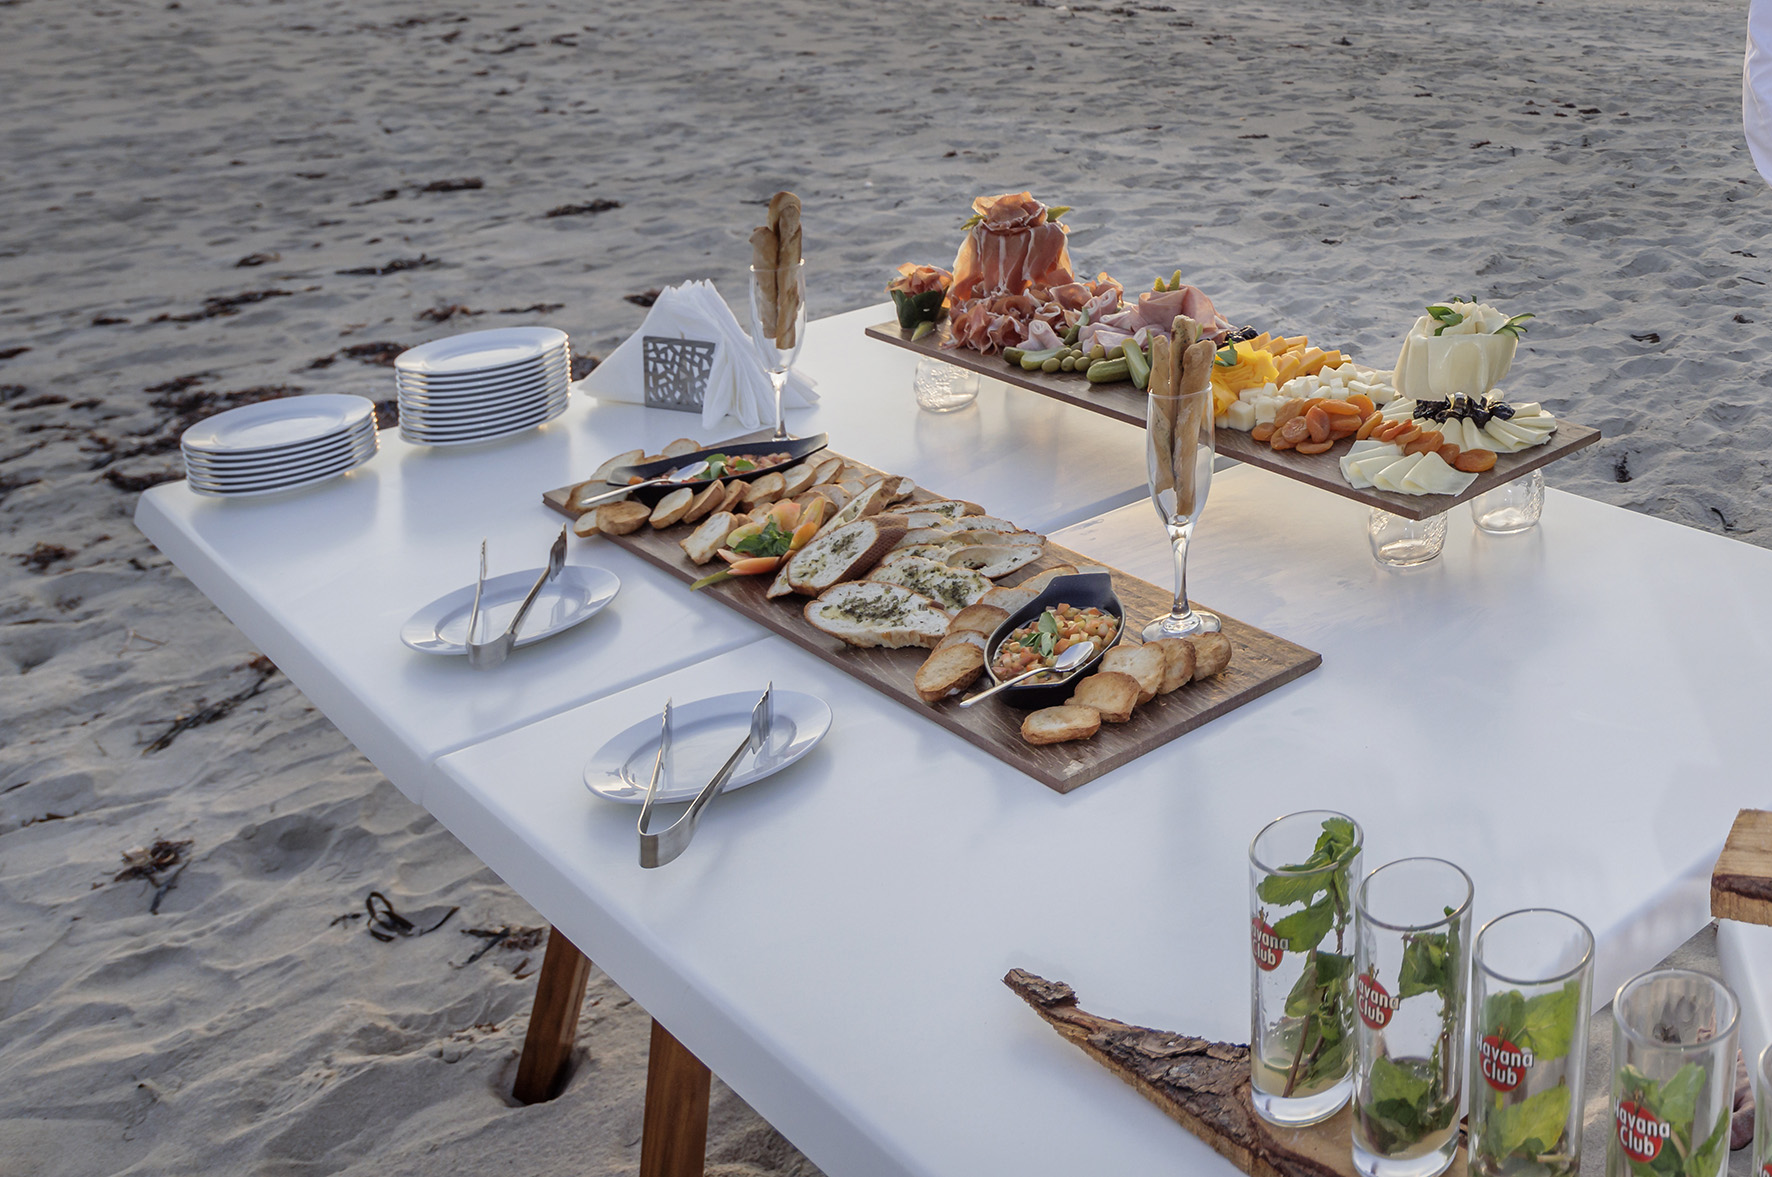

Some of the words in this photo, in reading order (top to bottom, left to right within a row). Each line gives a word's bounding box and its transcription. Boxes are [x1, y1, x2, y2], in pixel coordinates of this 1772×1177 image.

[1251, 924, 1289, 950] avana
[1253, 938, 1276, 966] Club
[1358, 978, 1399, 1010] avana
[1358, 994, 1385, 1025] Club
[1476, 1031, 1533, 1068] Havana
[1483, 1058, 1517, 1086] Club
[1614, 1096, 1670, 1138] Havana
[1620, 1125, 1655, 1157] Club
